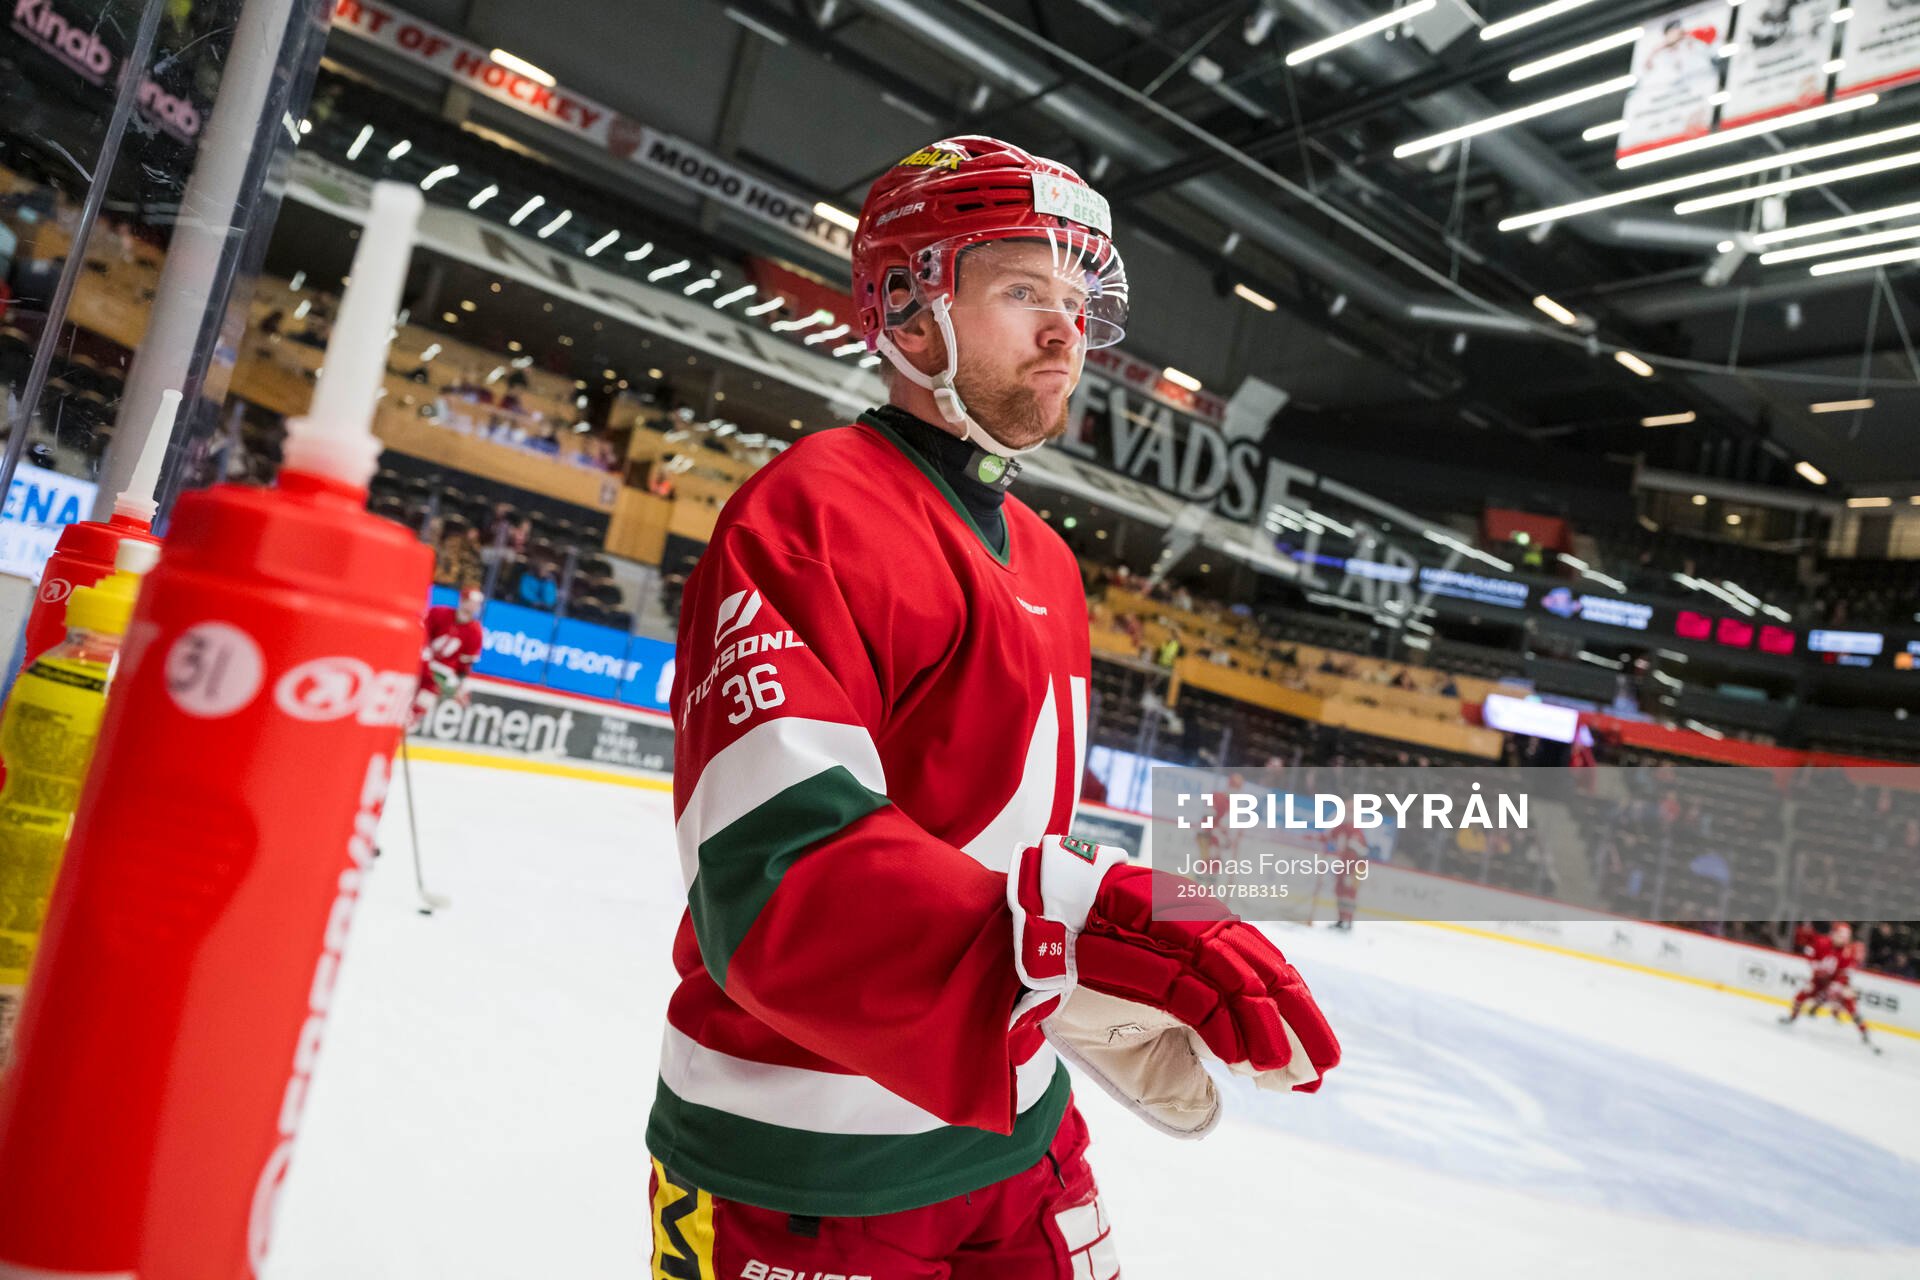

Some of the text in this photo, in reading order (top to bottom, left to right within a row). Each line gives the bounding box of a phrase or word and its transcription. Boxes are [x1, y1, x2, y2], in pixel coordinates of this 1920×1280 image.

[396, 24, 448, 57] OF
[453, 50, 601, 129] HOCKEY
[648, 140, 742, 198] MODO
[408, 692, 575, 758] lement
[721, 663, 786, 725] 36
